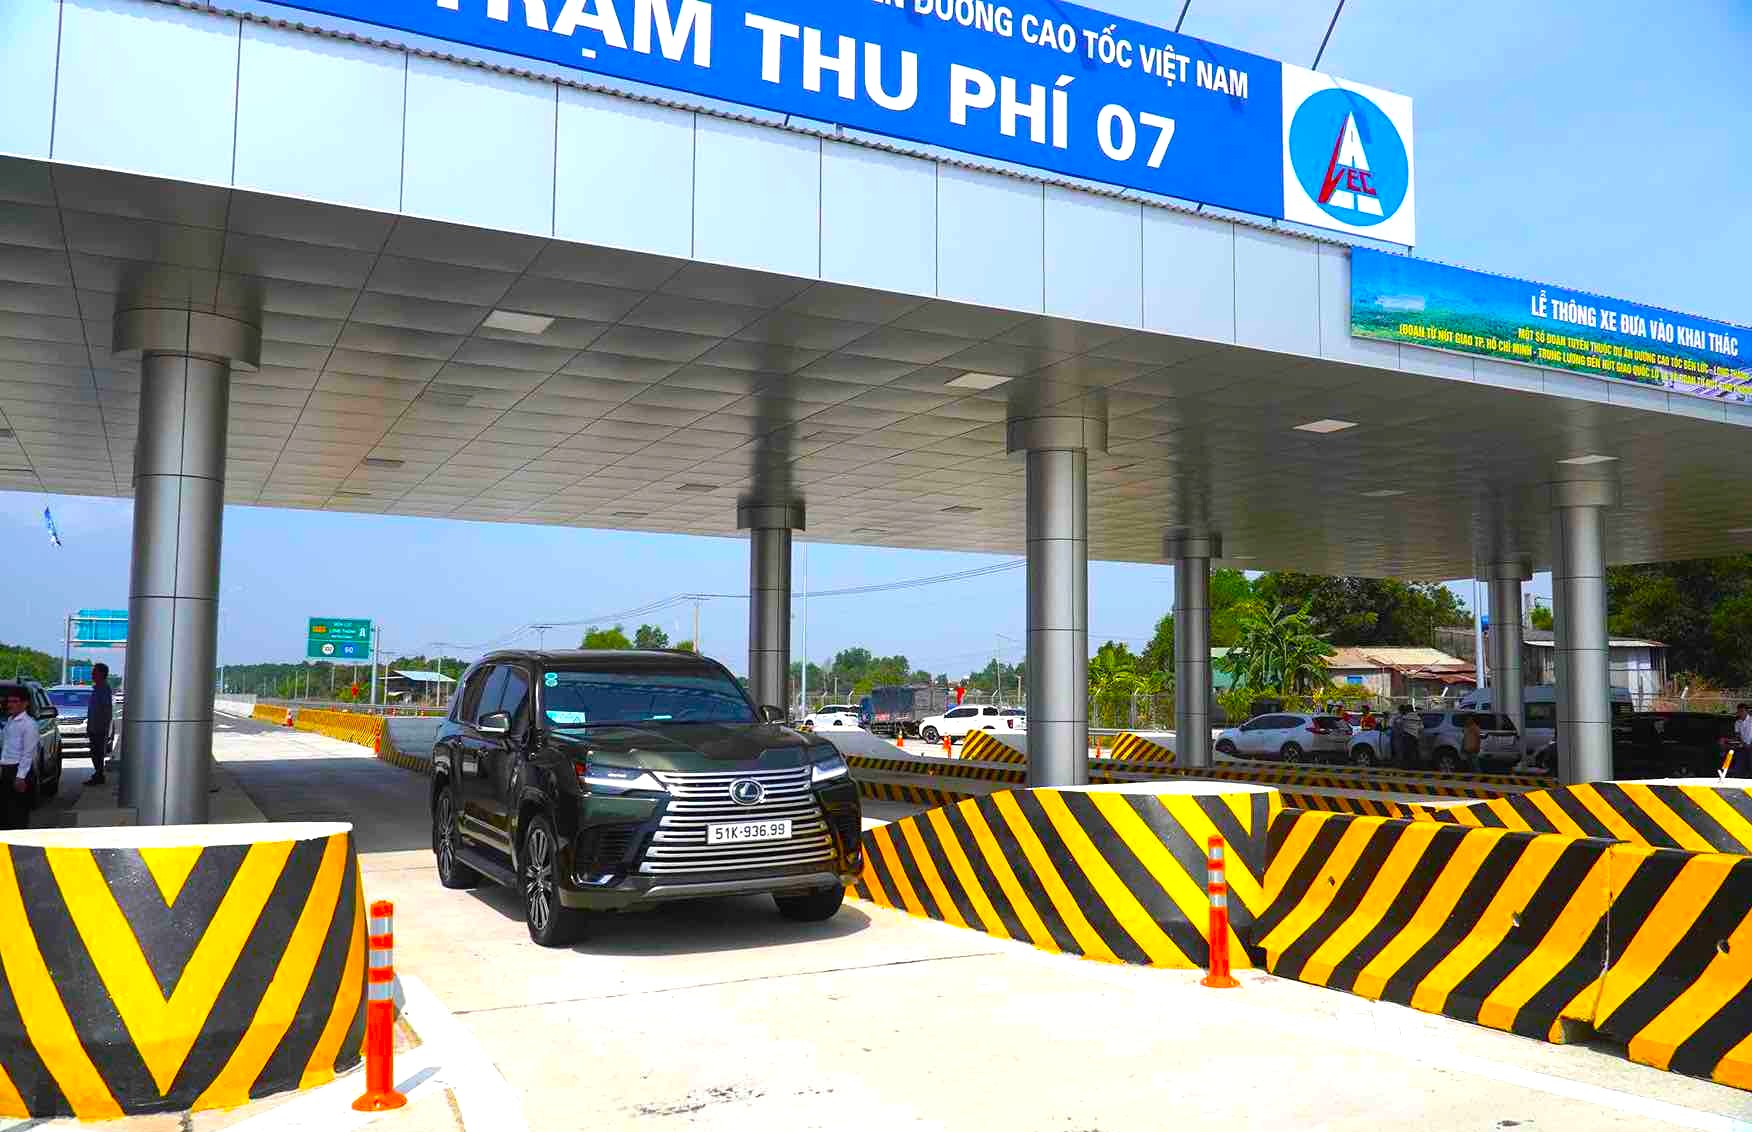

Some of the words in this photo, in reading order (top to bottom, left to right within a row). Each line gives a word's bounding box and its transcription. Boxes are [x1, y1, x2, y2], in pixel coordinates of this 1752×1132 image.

[437, 0, 711, 67] ẠM
[744, 12, 918, 112] THU
[949, 63, 1075, 150] PHÍ
[1096, 103, 1176, 169] 07
[1021, 14, 1077, 53] CAO
[1082, 24, 1133, 69] TỐC
[1139, 43, 1190, 87] VIỆT
[1196, 60, 1249, 99] NAM
[1531, 289, 1548, 318] LỄ
[1551, 298, 1597, 328] THÔNG
[1600, 309, 1617, 332] XE
[1620, 313, 1647, 338] ĐƯA
[1649, 318, 1674, 344] VÀO
[1677, 326, 1705, 350] KHAI
[1708, 332, 1738, 357] THÁC
[715, 823, 785, 840] 51K-936.99
